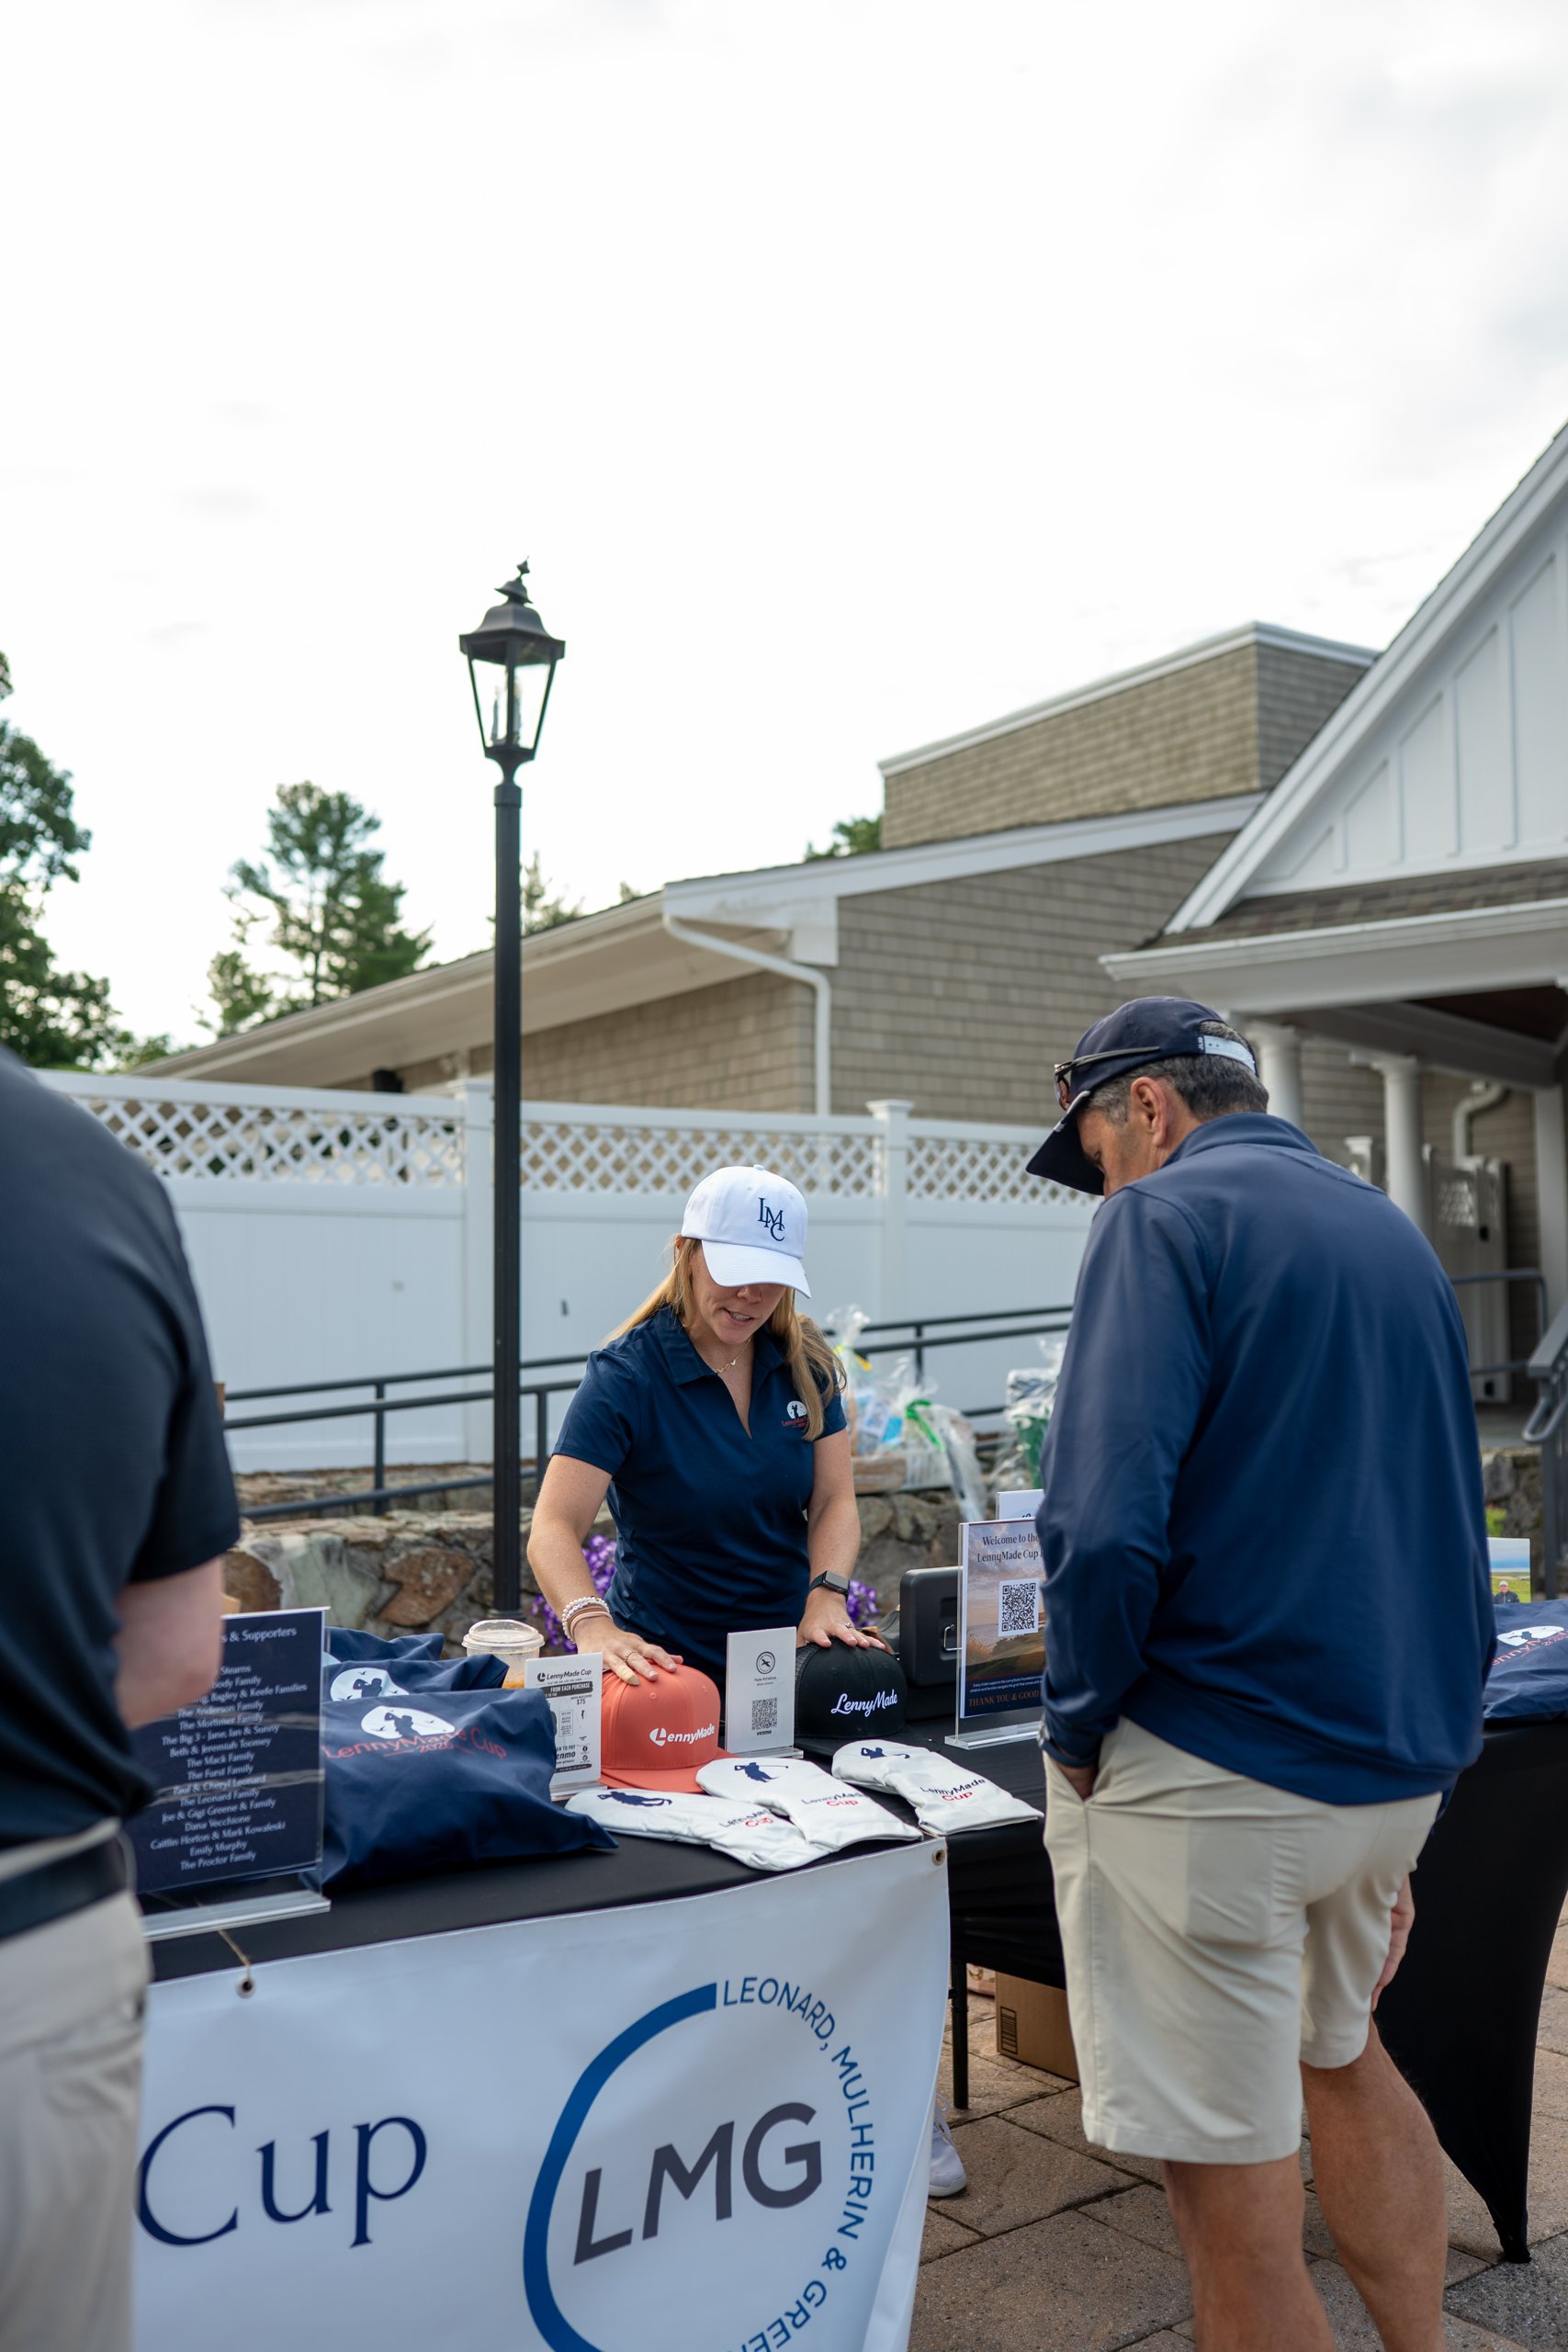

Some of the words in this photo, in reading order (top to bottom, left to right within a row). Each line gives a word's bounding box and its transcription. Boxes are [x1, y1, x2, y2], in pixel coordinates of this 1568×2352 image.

[757, 1197, 785, 1242] LMC
[982, 1535, 1018, 1546] Welcome
[1018, 1533, 1026, 1543] to
[1027, 1532, 1040, 1543] the
[976, 1550, 1021, 1564] LennyMade
[1022, 1549, 1039, 1560] Cup
[229, 1631, 239, 1643] &
[241, 1627, 298, 1644] Supporters
[234, 1675, 264, 1688] Family
[547, 1669, 580, 1680] LennyMade
[580, 1668, 592, 1677] Cup
[240, 1689, 248, 1699] &
[250, 1686, 275, 1697] Keefe
[275, 1683, 308, 1694] Families
[571, 1682, 591, 1690] PURCHASE
[830, 1689, 898, 1718] LennyMade
[969, 1695, 996, 1707] THANK
[996, 1693, 1010, 1703] YOU
[1010, 1692, 1018, 1701] &
[1018, 1690, 1040, 1700] GOOD
[177, 1709, 194, 1718] The
[196, 1703, 236, 1716] Anderson
[236, 1700, 265, 1712] Family
[179, 1721, 196, 1731] The
[197, 1716, 236, 1728] Mortimer
[236, 1712, 265, 1724] Family
[162, 1736, 177, 1746] The
[179, 1734, 194, 1745] Big
[194, 1732, 201, 1742] 3
[243, 1726, 252, 1736] &
[253, 1724, 280, 1735] Sunny
[322, 1729, 467, 1759] LennyMade
[469, 1725, 507, 1759] Cup
[649, 1724, 716, 1747] LennyMade
[169, 1747, 189, 1758] Beth
[190, 1746, 199, 1755] &
[200, 1743, 238, 1755] Jeremiah
[239, 1737, 273, 1748] Toomey
[556, 1751, 576, 1759] enmo
[186, 1758, 202, 1768] The
[204, 1755, 227, 1765] Mack
[228, 1750, 255, 1762] Family
[187, 1770, 203, 1781] The
[204, 1767, 226, 1779] Furst
[227, 1763, 254, 1775] Family
[173, 1785, 192, 1796] Paul
[192, 1783, 201, 1793] &
[202, 1778, 232, 1792] Cheryl
[232, 1772, 267, 1787] Leonard
[919, 1779, 986, 1796] LennyMade
[179, 1797, 196, 1807] The
[197, 1791, 232, 1804] Leonard
[232, 1787, 260, 1800] Family
[942, 1792, 974, 1802] Cup
[162, 1813, 176, 1825] Joe
[176, 1810, 186, 1820] &
[186, 1807, 206, 1820] Gigi
[207, 1804, 238, 1816] Greene
[239, 1801, 249, 1811] &
[249, 1797, 276, 1809] Family
[208, 1815, 253, 1827] Vecchione
[745, 1817, 773, 1827] Cup
[180, 1833, 210, 1845] Horton
[211, 1830, 220, 1839] &
[189, 1845, 214, 1857] Emily
[214, 1839, 248, 1853] Murphy
[179, 1860, 197, 1871] The
[197, 1856, 229, 1869] Proctor
[229, 1849, 257, 1862] Family
[722, 1976, 836, 2051] LEONARD,
[830, 2045, 874, 2240] MULHERIN
[134, 2104, 427, 2249] Cup
[573, 2102, 823, 2266] LMG
[820, 2247, 847, 2271] &
